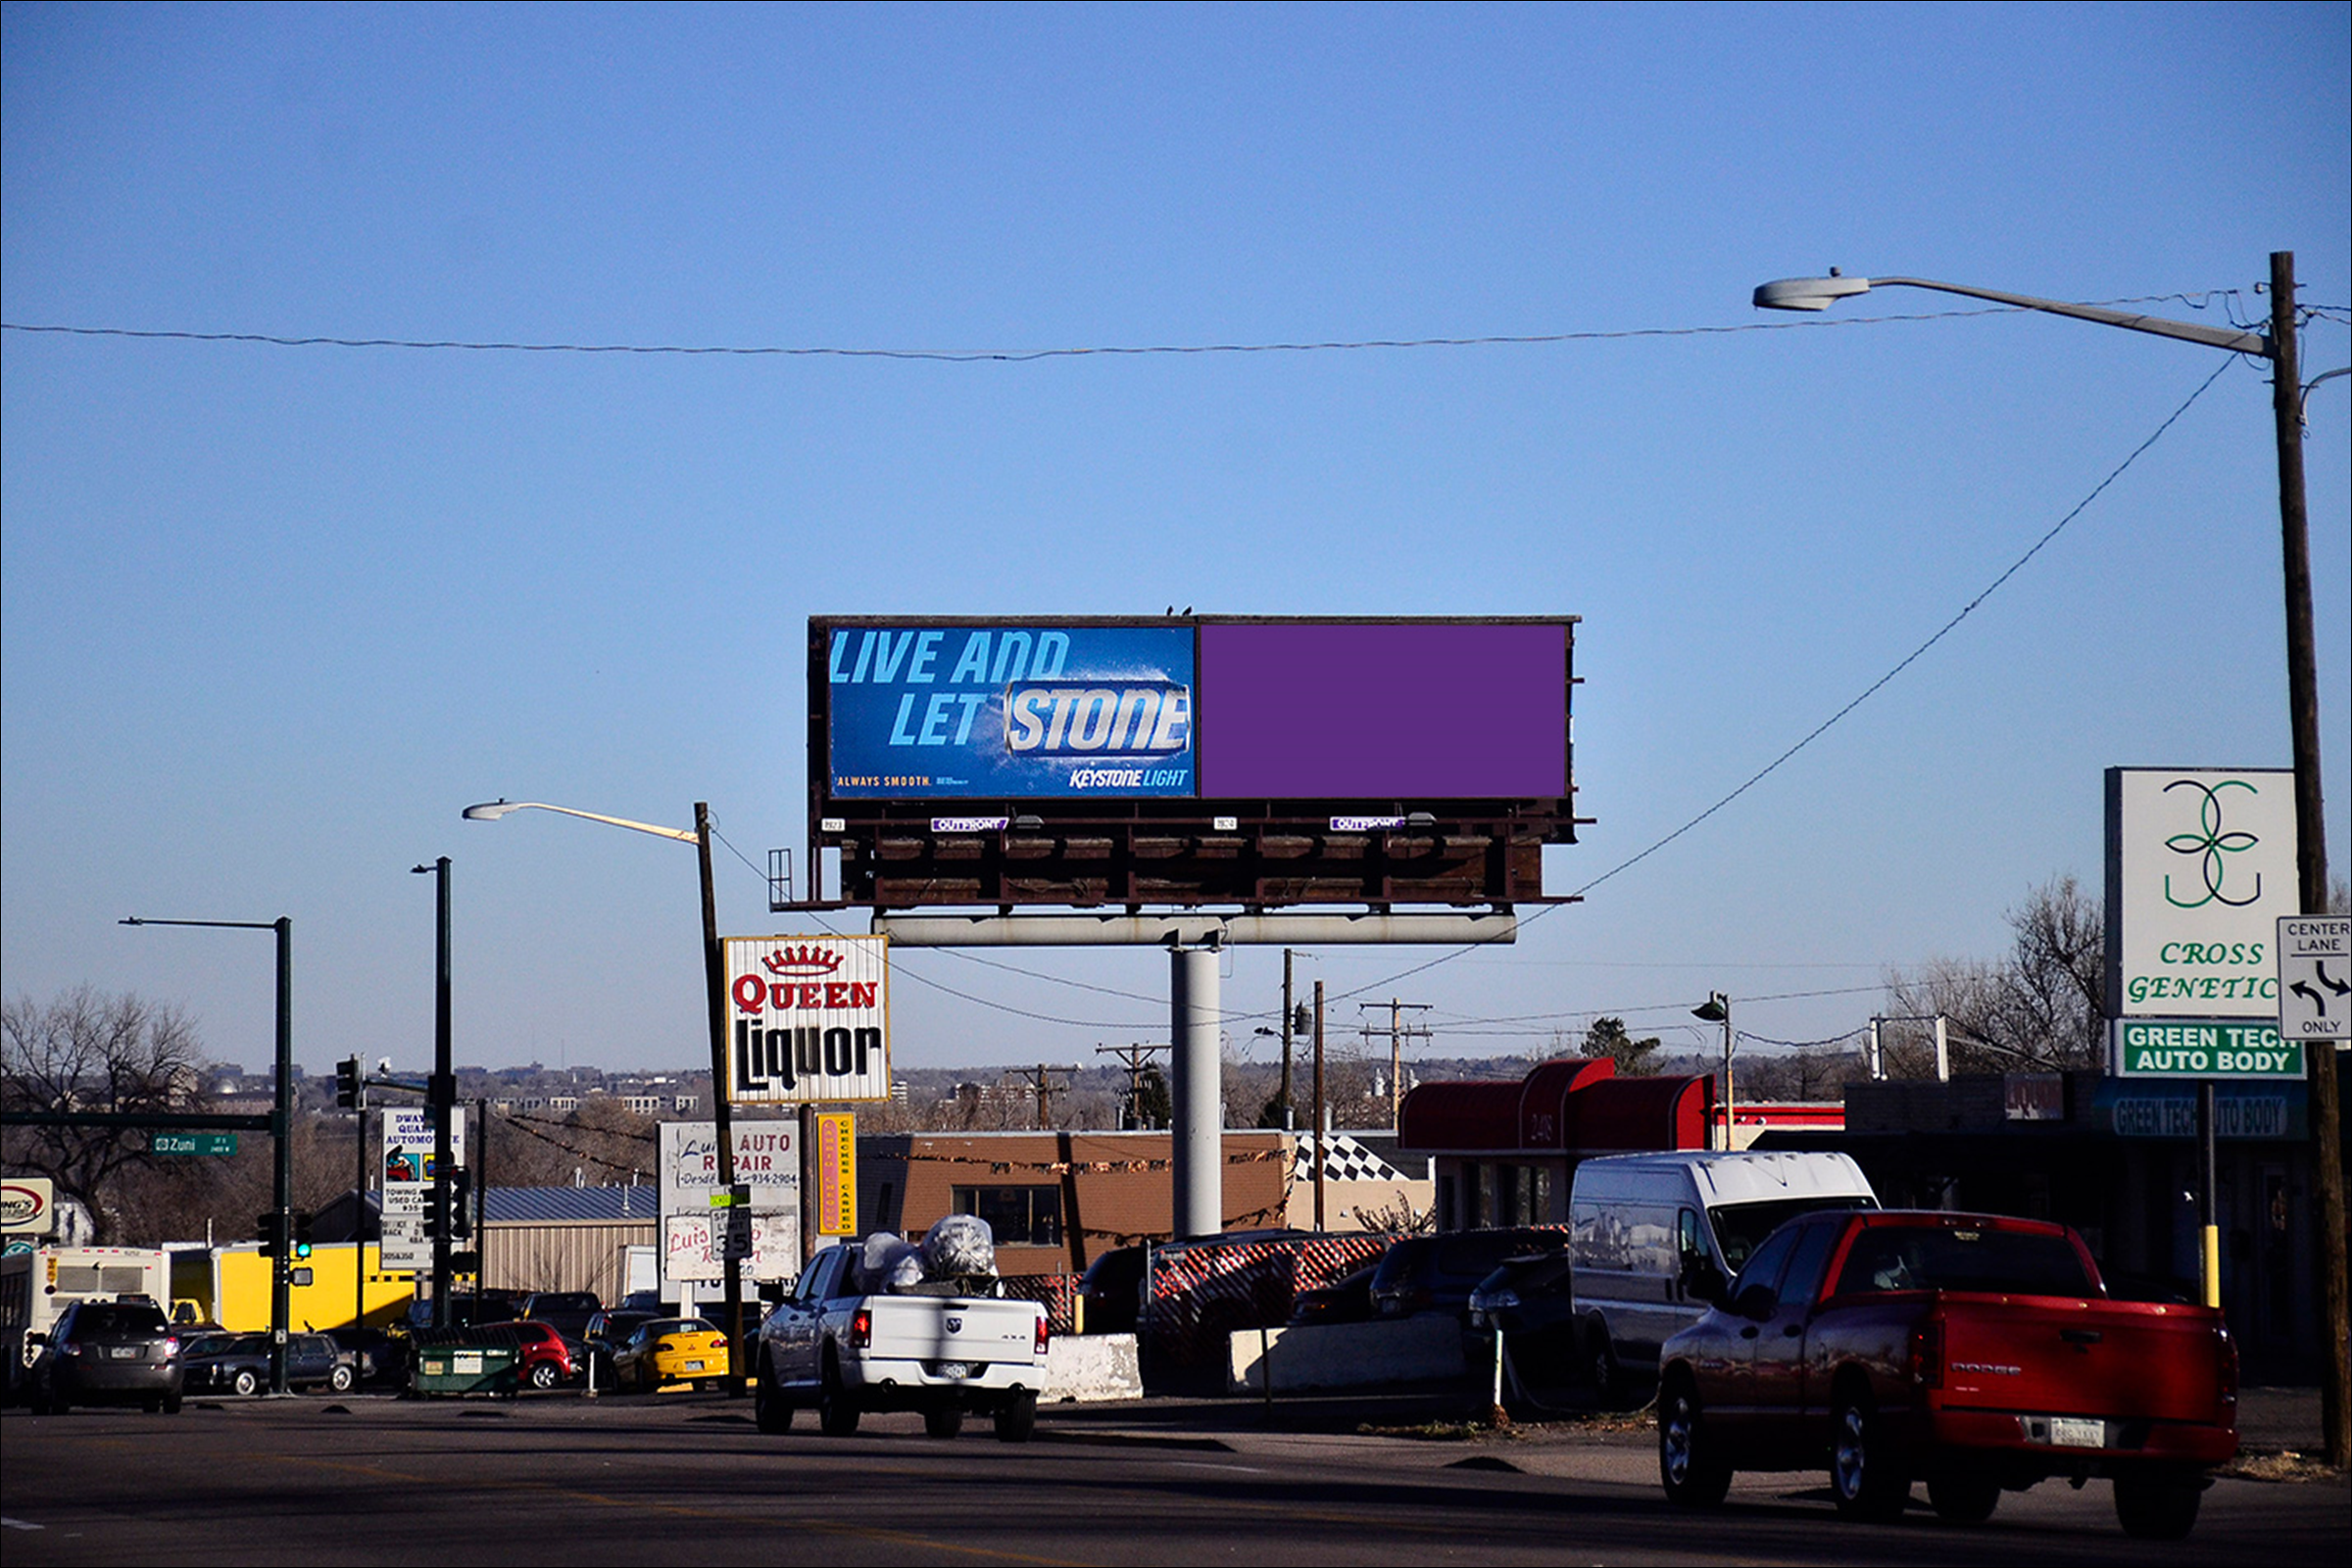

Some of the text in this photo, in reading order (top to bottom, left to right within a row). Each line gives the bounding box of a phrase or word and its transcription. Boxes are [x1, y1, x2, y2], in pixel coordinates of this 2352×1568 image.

[830, 630, 1071, 684] LIVE AND
[889, 692, 988, 746] LET
[1009, 688, 1188, 752] STONE
[837, 775, 880, 787] ALWAYS
[1069, 768, 1188, 789] KEYSTONE LIGHT
[938, 818, 999, 830] OUTFRONT
[2287, 922, 2351, 937] CENTER
[2160, 942, 2265, 965] CROSS
[2297, 938, 2342, 952] LANE
[731, 973, 878, 1015] QUEEN
[2128, 976, 2278, 1004] GENETIC
[2301, 1020, 2342, 1034] ONLY
[2128, 1028, 2219, 1049] GREEN
[735, 1018, 882, 1092] Liquor
[2136, 1051, 2290, 1071] AUTO BODY
[2117, 1100, 2161, 1135] GREEN
[2213, 1099, 2240, 1135] UTO
[2243, 1098, 2282, 1135] BODY
[170, 1137, 196, 1152] Zuni
[386, 1135, 461, 1145] AUTOMOE
[681, 1134, 791, 1159] Lui AUTO
[703, 1155, 772, 1171] RPAIR
[385, 1188, 417, 1197] TOWING
[388, 1196, 411, 1204] USED
[713, 1210, 749, 1222] SPEED
[841, 1183, 852, 1230] CASHED
[716, 1222, 745, 1232] LIMIT
[715, 1233, 749, 1254] 35
[1951, 1361, 2022, 1376] DODGE
